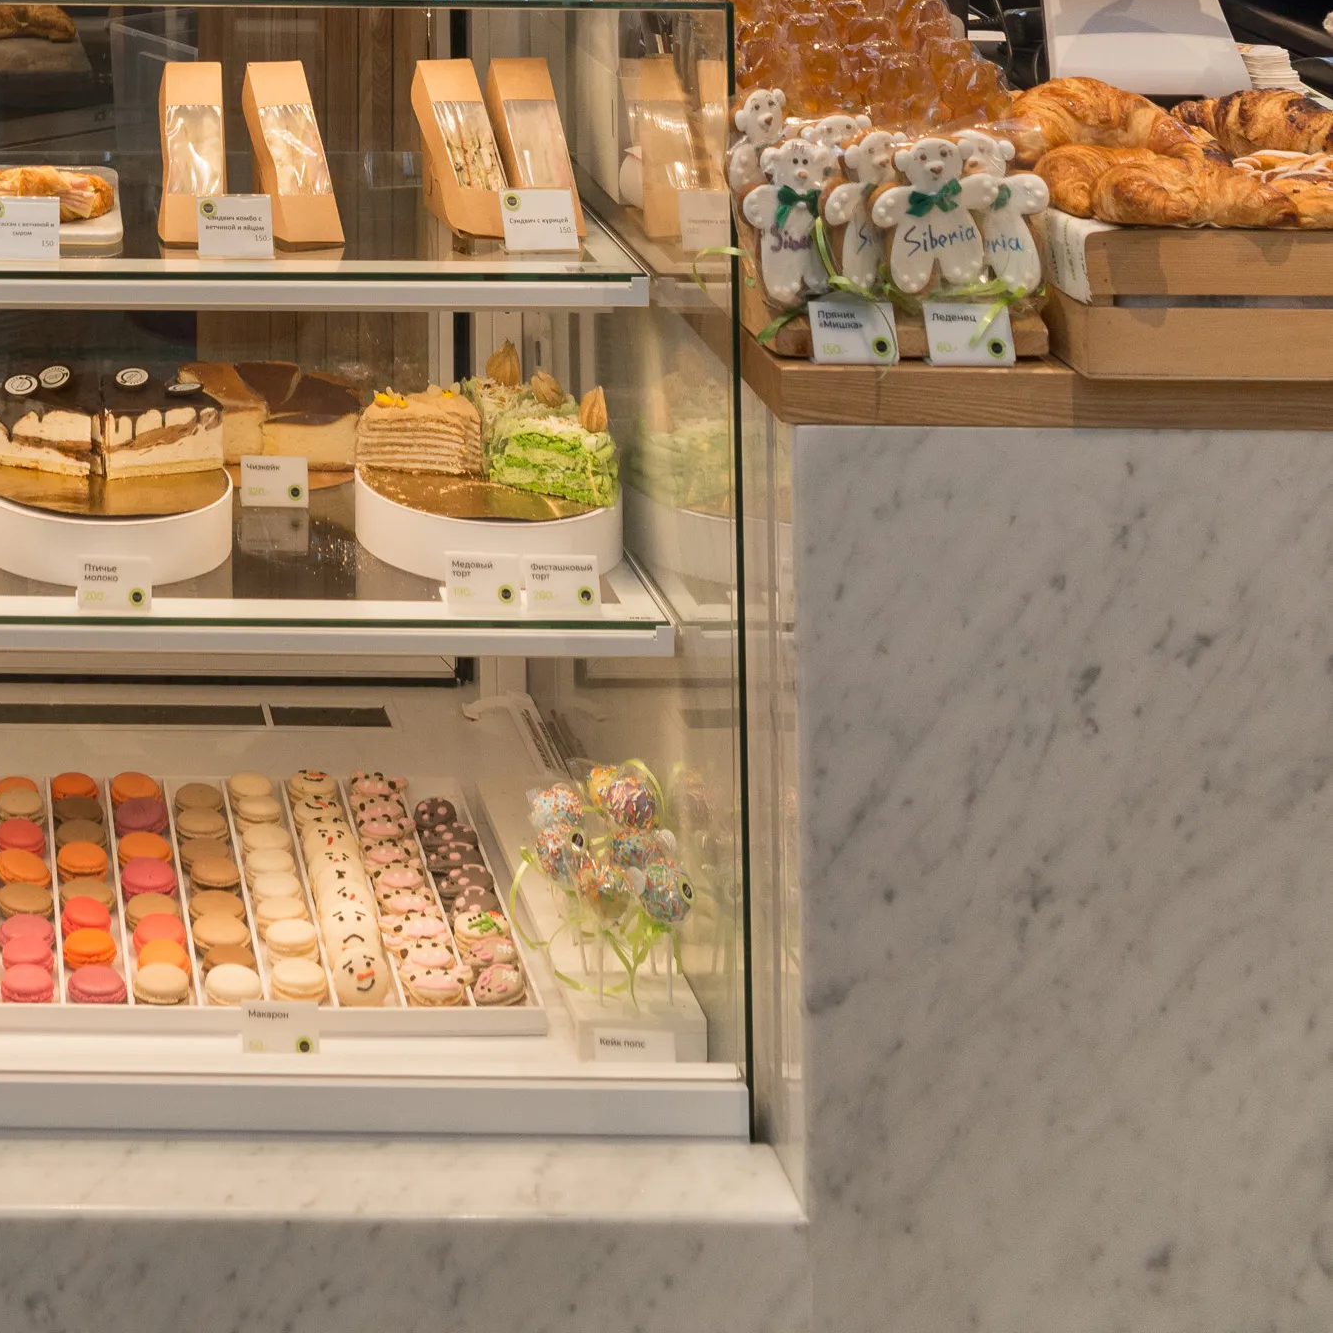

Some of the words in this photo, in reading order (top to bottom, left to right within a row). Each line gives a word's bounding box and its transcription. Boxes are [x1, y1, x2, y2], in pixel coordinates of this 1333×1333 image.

[904, 224, 976, 257] Siberia
[818, 310, 856, 321] Пряник
[932, 312, 977, 324] Леденец
[819, 321, 863, 330] «Мишка»
[247, 463, 280, 471] Чизкейк
[84, 563, 117, 572] Птичье
[452, 561, 493, 570] Медовый
[531, 563, 593, 572] Фисташковый
[84, 574, 118, 582] молоко
[532, 573, 550, 581] торт
[248, 1010, 289, 1020] Макарон
[599, 1037, 621, 1046] Кейк
[623, 1039, 646, 1049] попс
